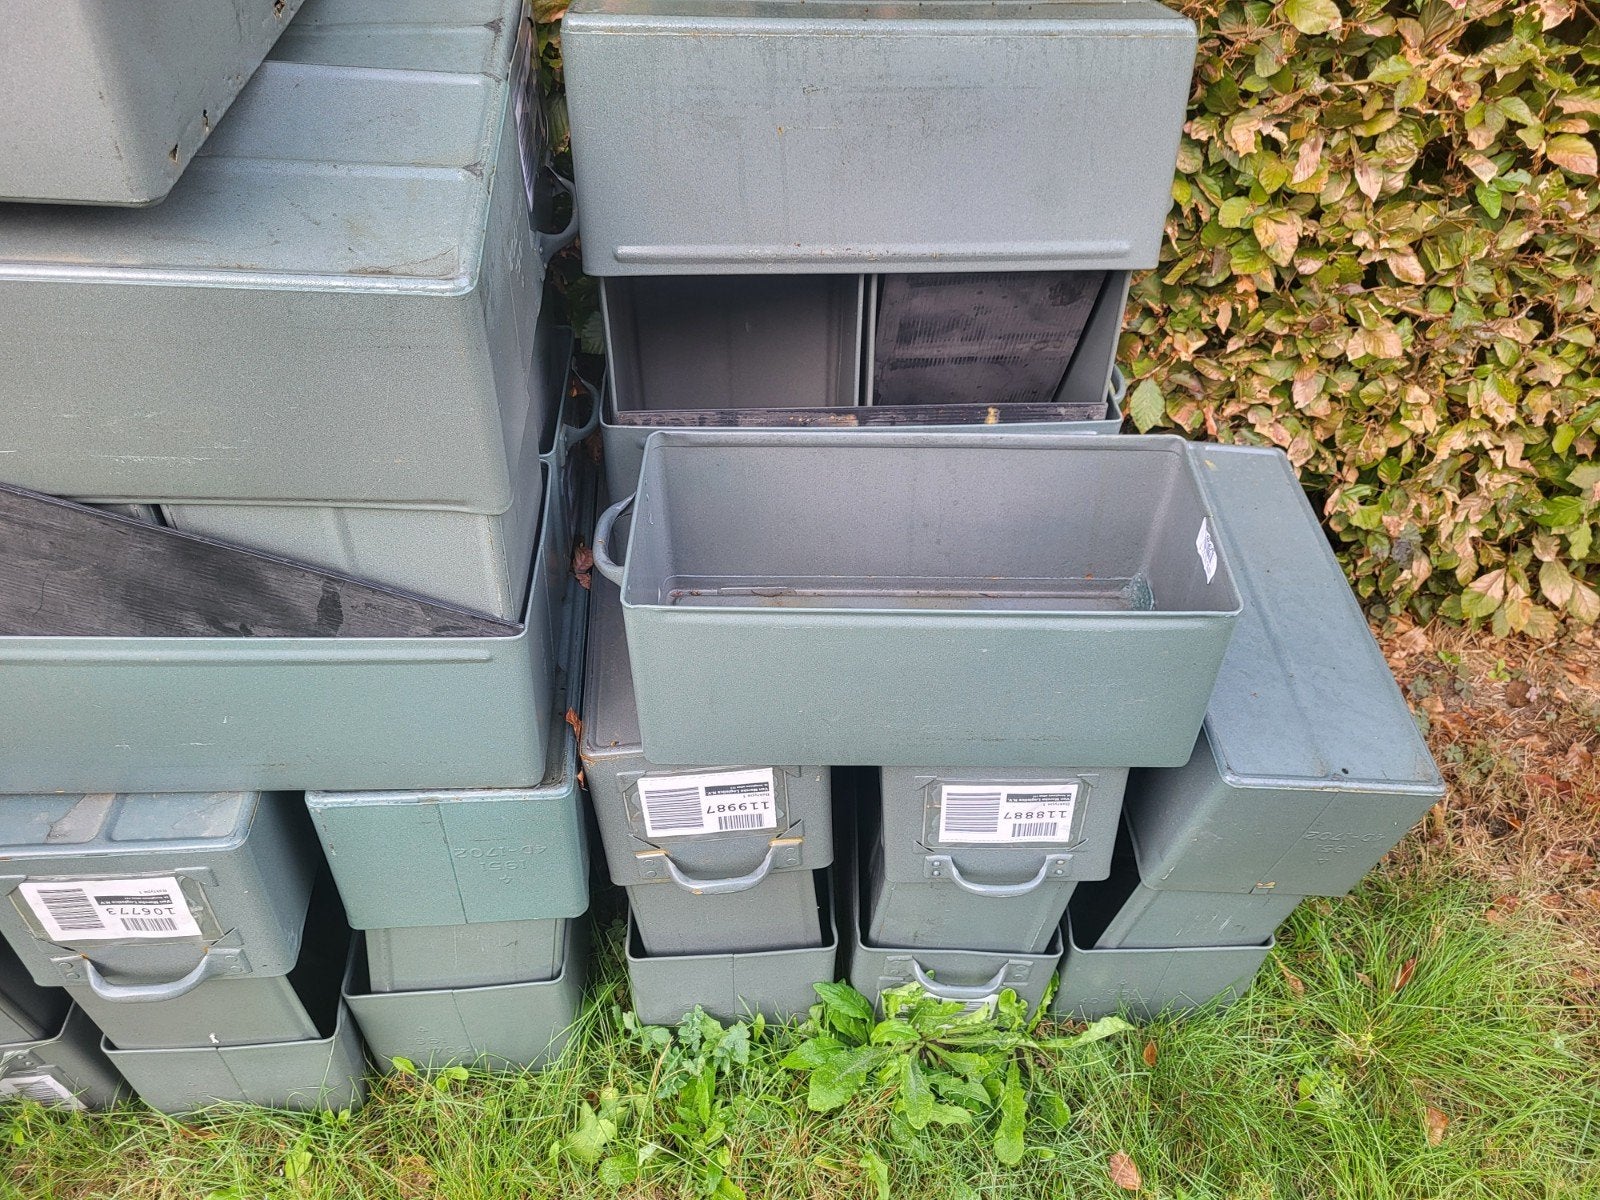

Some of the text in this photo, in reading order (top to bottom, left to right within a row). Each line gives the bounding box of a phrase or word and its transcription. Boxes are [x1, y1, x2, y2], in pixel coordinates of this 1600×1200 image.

[706, 802, 770, 814] 119987
[1003, 810, 1068, 820] 118887
[106, 908, 176, 916] 106773
